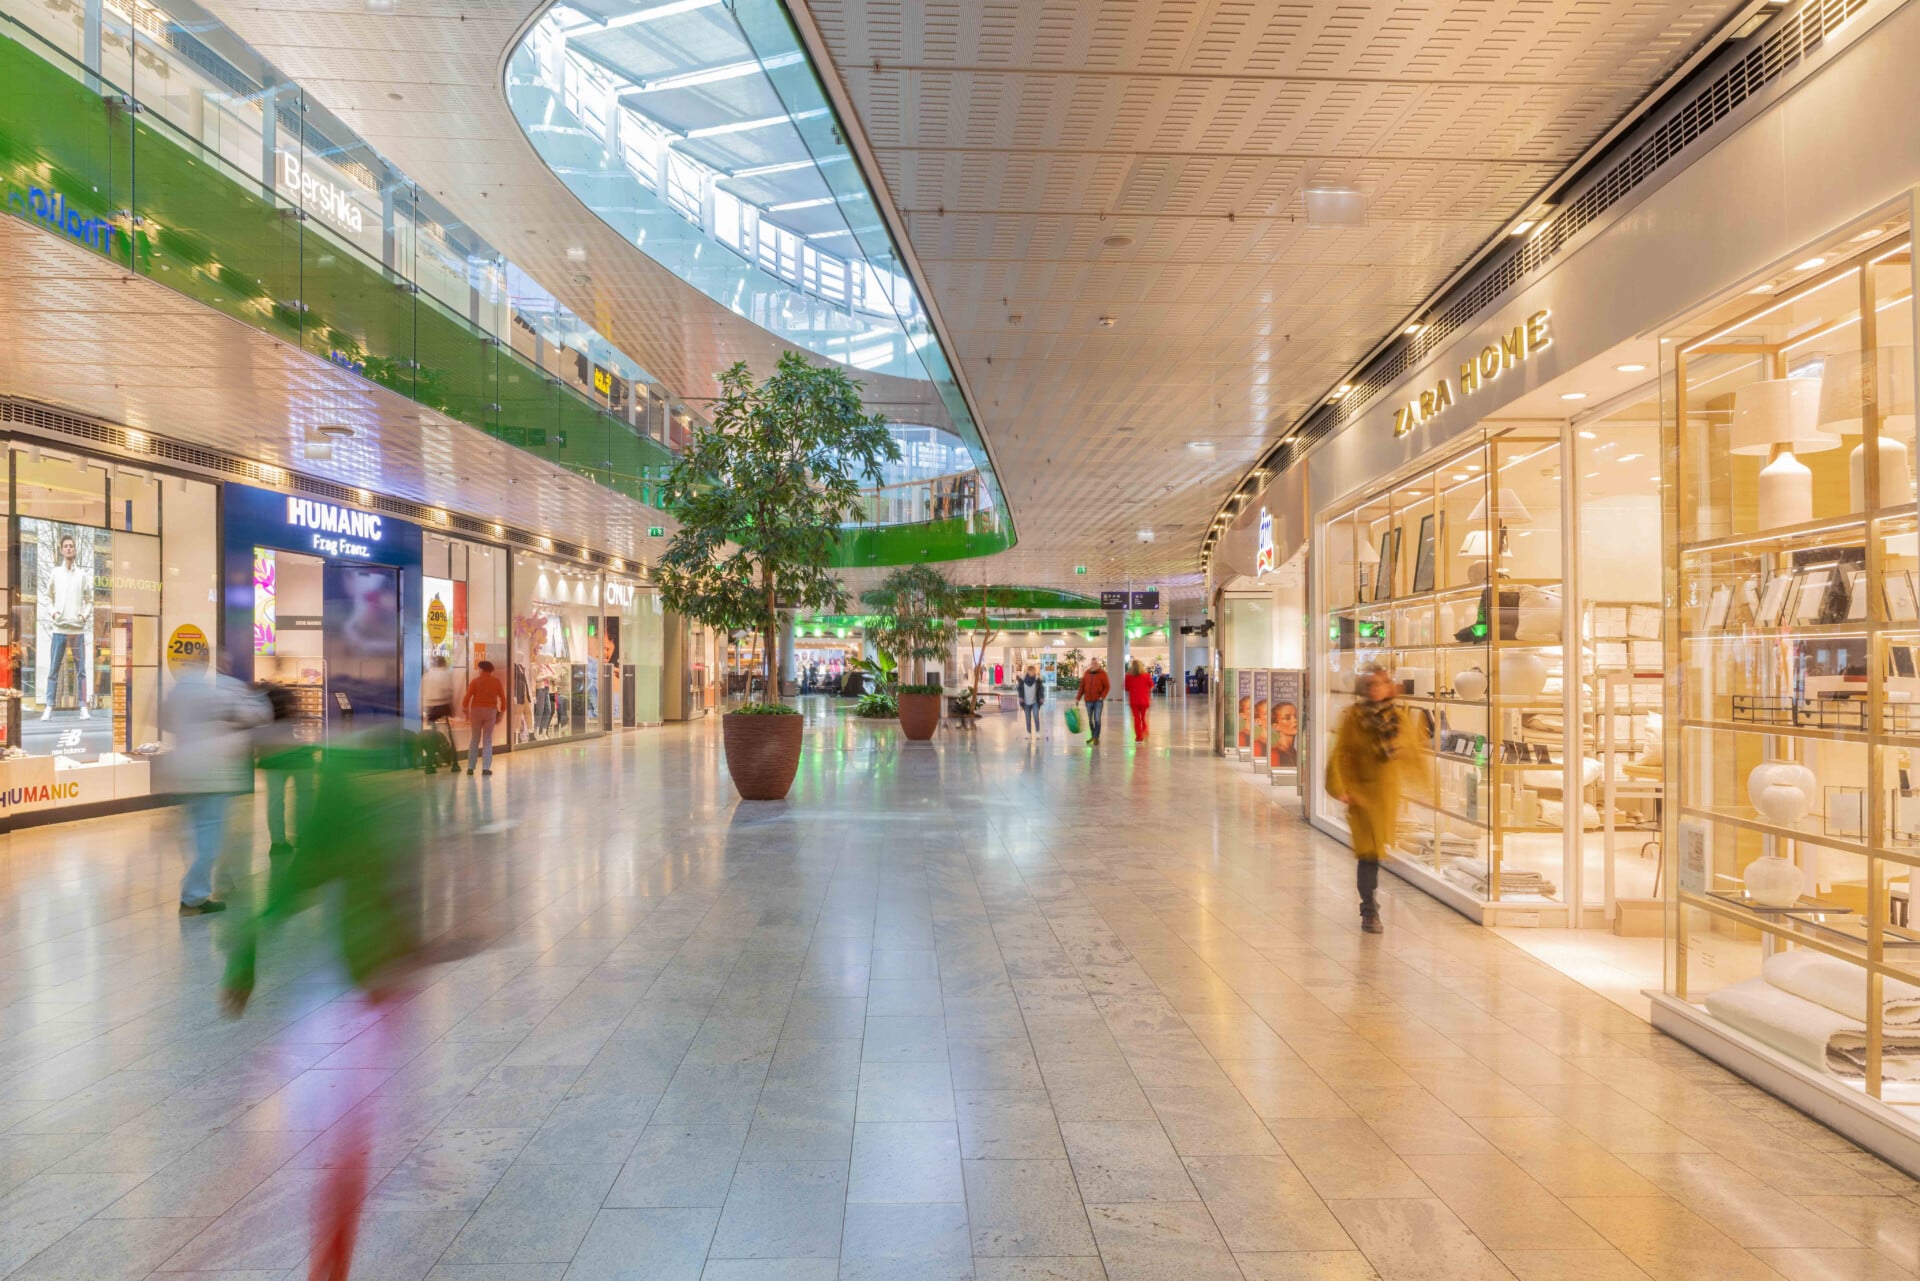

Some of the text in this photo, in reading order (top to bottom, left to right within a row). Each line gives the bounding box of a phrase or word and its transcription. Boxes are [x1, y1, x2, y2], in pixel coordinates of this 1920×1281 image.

[284, 151, 362, 233] Bershka
[1393, 309, 1553, 439] ZARA HOME
[287, 496, 382, 541] HUMANIC
[313, 533, 338, 556] Frag
[606, 582, 635, 607] ONLY
[168, 640, 208, 656] -20%
